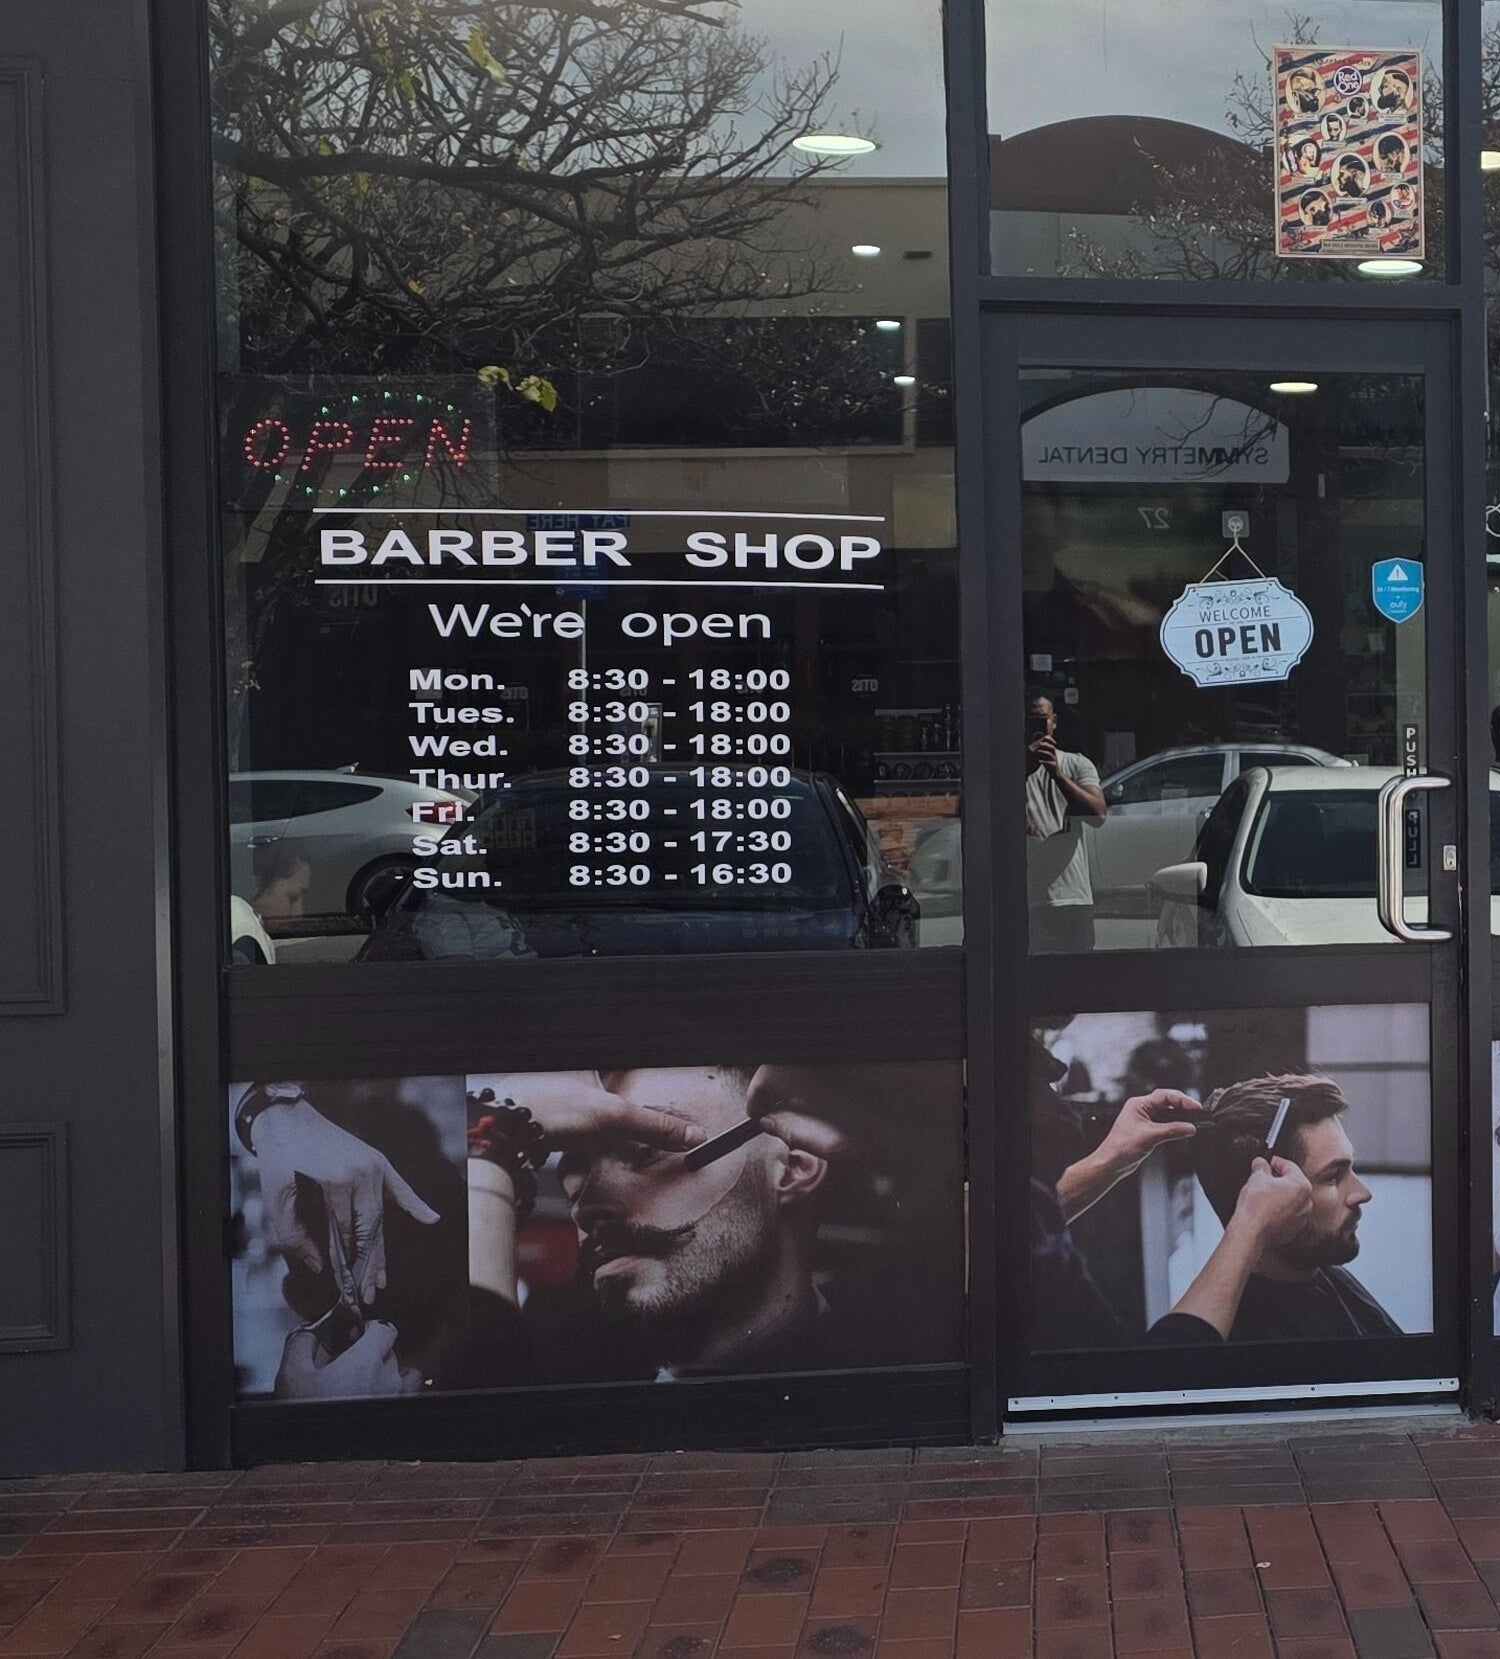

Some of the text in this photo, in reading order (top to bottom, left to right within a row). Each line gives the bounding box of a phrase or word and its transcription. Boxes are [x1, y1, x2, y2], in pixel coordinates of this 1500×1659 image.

[1337, 71, 1358, 82] Red
[1338, 81, 1359, 92] One
[243, 418, 472, 471] OPEN
[320, 529, 881, 571] BARBER SHOP
[1199, 605, 1272, 623] WELCOME
[621, 612, 771, 646] open
[1195, 622, 1282, 658] OPEN
[409, 669, 505, 690] Mon.
[568, 668, 649, 690] 8:30
[688, 668, 790, 690] 18:00
[408, 702, 514, 724] Tues.
[568, 701, 649, 723] 8:30
[688, 701, 791, 723] 18:00
[408, 735, 508, 757] Wed.
[568, 734, 650, 755] 8:30
[688, 733, 791, 755] 18:00
[1406, 727, 1416, 777] PUSH
[409, 768, 511, 790] Thur.
[568, 767, 650, 788] 8:30
[689, 766, 791, 788] 18:00
[412, 801, 475, 823] Fri.
[568, 799, 650, 821] 8:30
[689, 798, 792, 820] 18:00
[412, 834, 487, 856] Sat.
[568, 832, 650, 853] 8:30
[690, 830, 792, 853] 17:30
[412, 867, 502, 889] Sun.
[569, 864, 651, 886] 8:30
[690, 863, 792, 885] 16:30
